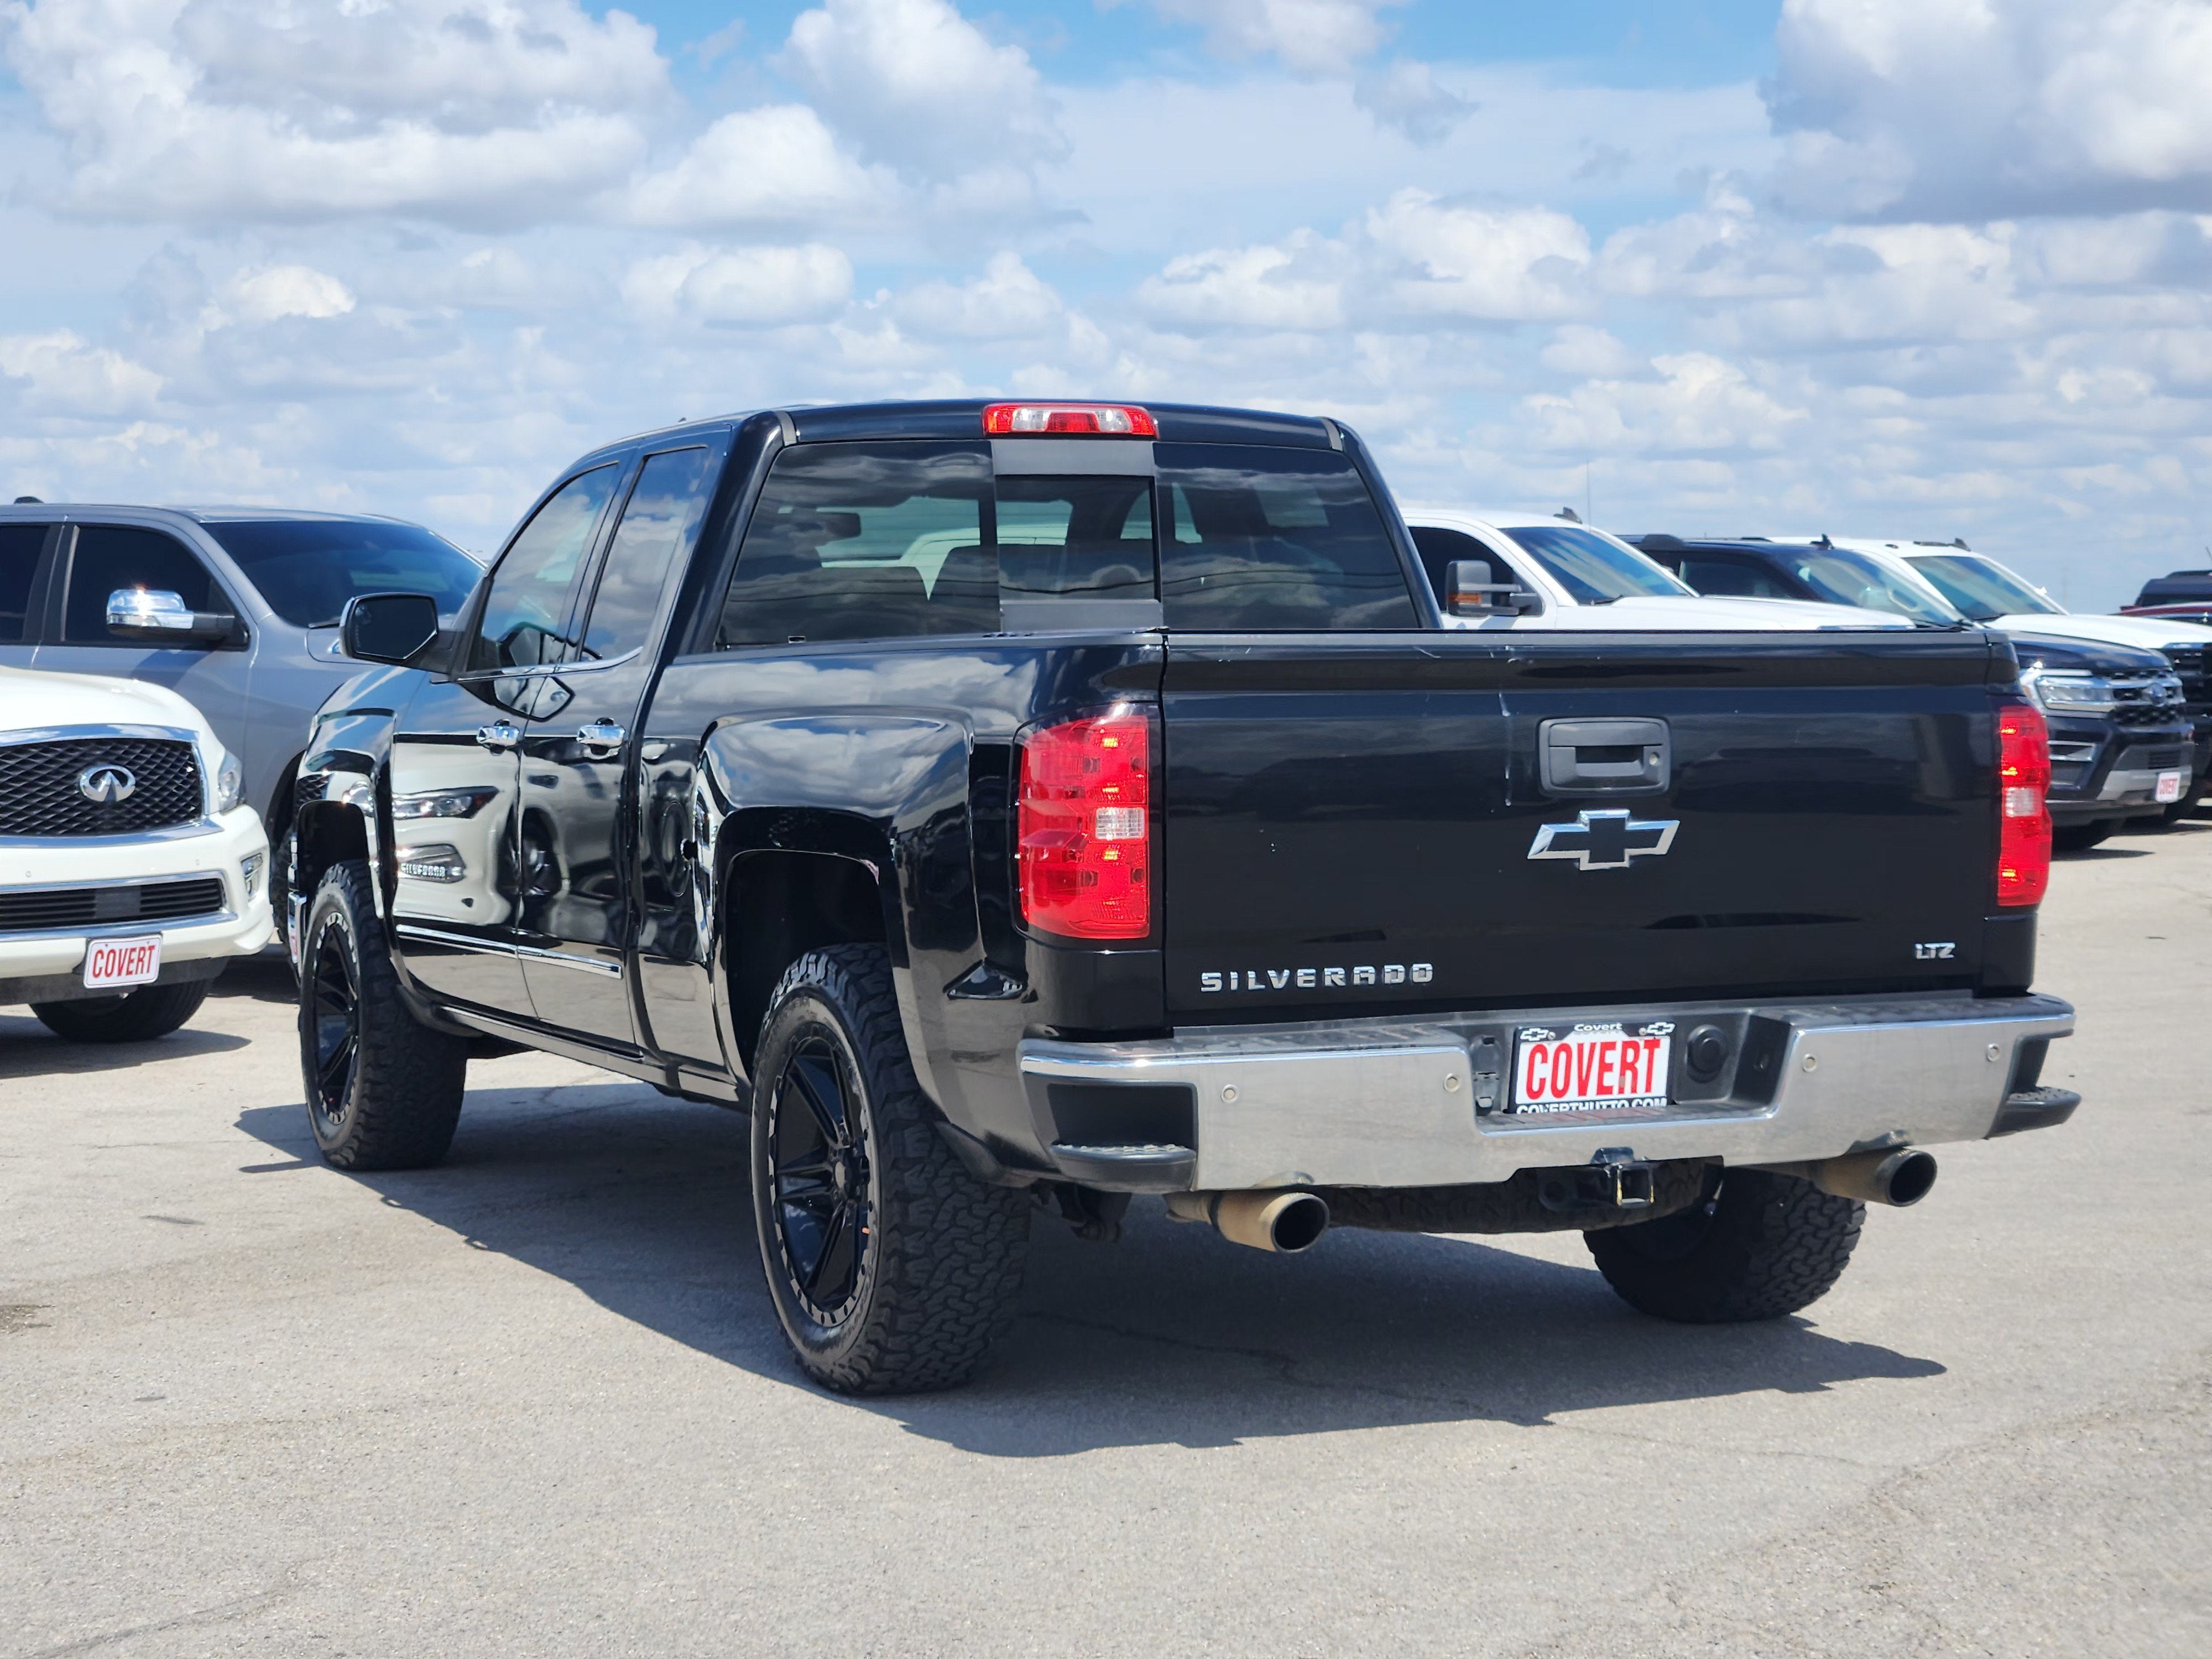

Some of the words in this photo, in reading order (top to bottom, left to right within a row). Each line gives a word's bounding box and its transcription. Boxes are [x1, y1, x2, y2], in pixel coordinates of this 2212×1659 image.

[92, 945, 155, 978] COVERT
[1915, 942, 1955, 959] LTZ
[1201, 962, 1433, 992] SILVERADO
[1574, 1022, 1623, 1031] Covert
[1526, 1039, 1661, 1100] COVERT
